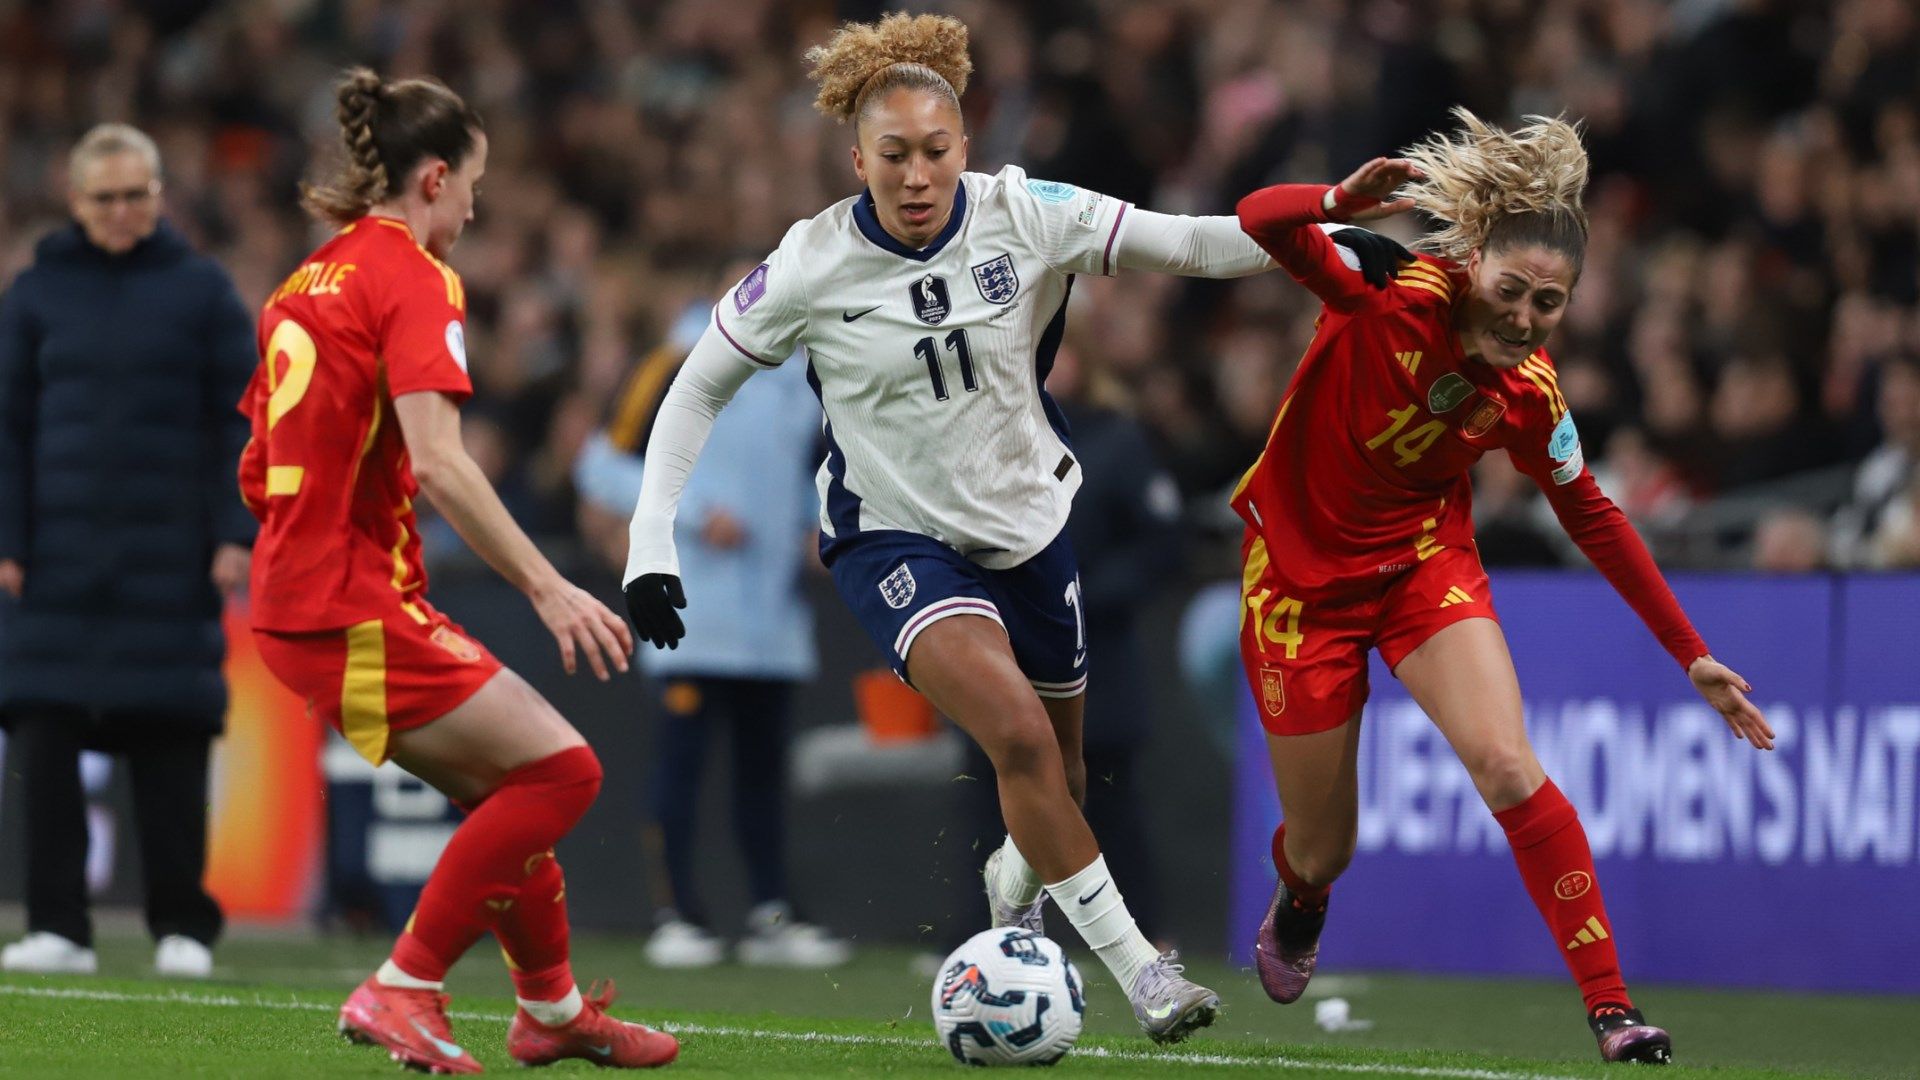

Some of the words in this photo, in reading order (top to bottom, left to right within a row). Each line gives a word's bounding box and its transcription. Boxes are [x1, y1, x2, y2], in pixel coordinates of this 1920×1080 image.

[913, 328, 978, 401] 11
[266, 319, 318, 498] 2
[1365, 403, 1447, 467] 14
[1247, 588, 1304, 659] 14
